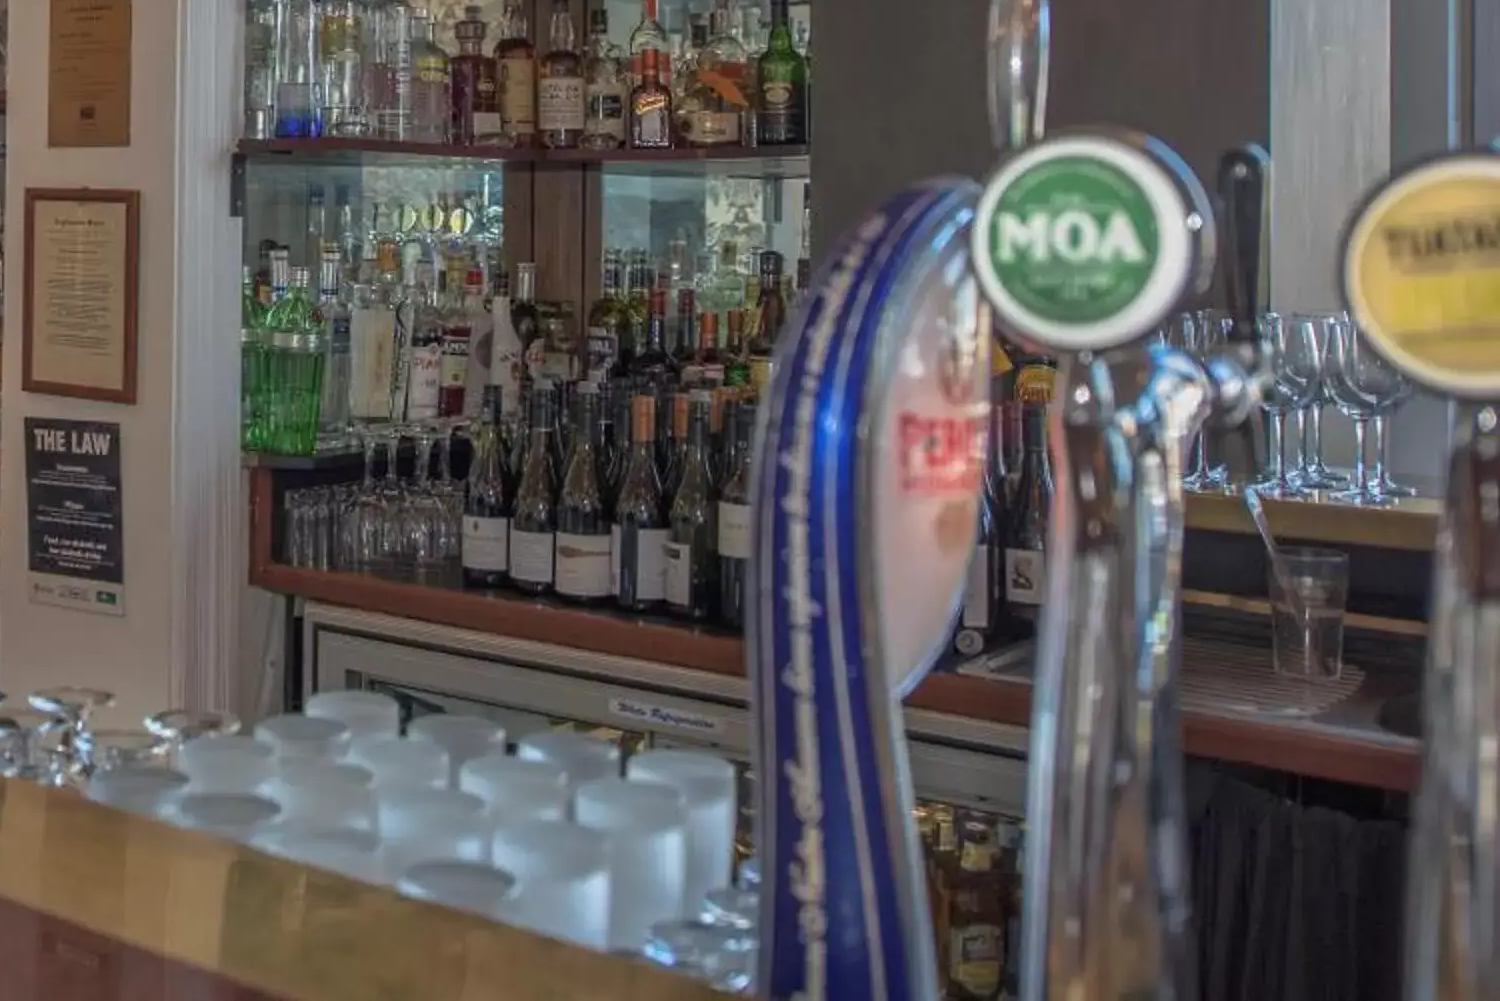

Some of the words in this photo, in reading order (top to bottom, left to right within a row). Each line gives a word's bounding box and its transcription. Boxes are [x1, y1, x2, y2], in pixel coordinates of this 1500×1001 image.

[996, 209, 1146, 263] MOA
[34, 428, 66, 451] THE
[71, 431, 111, 456] LAW
